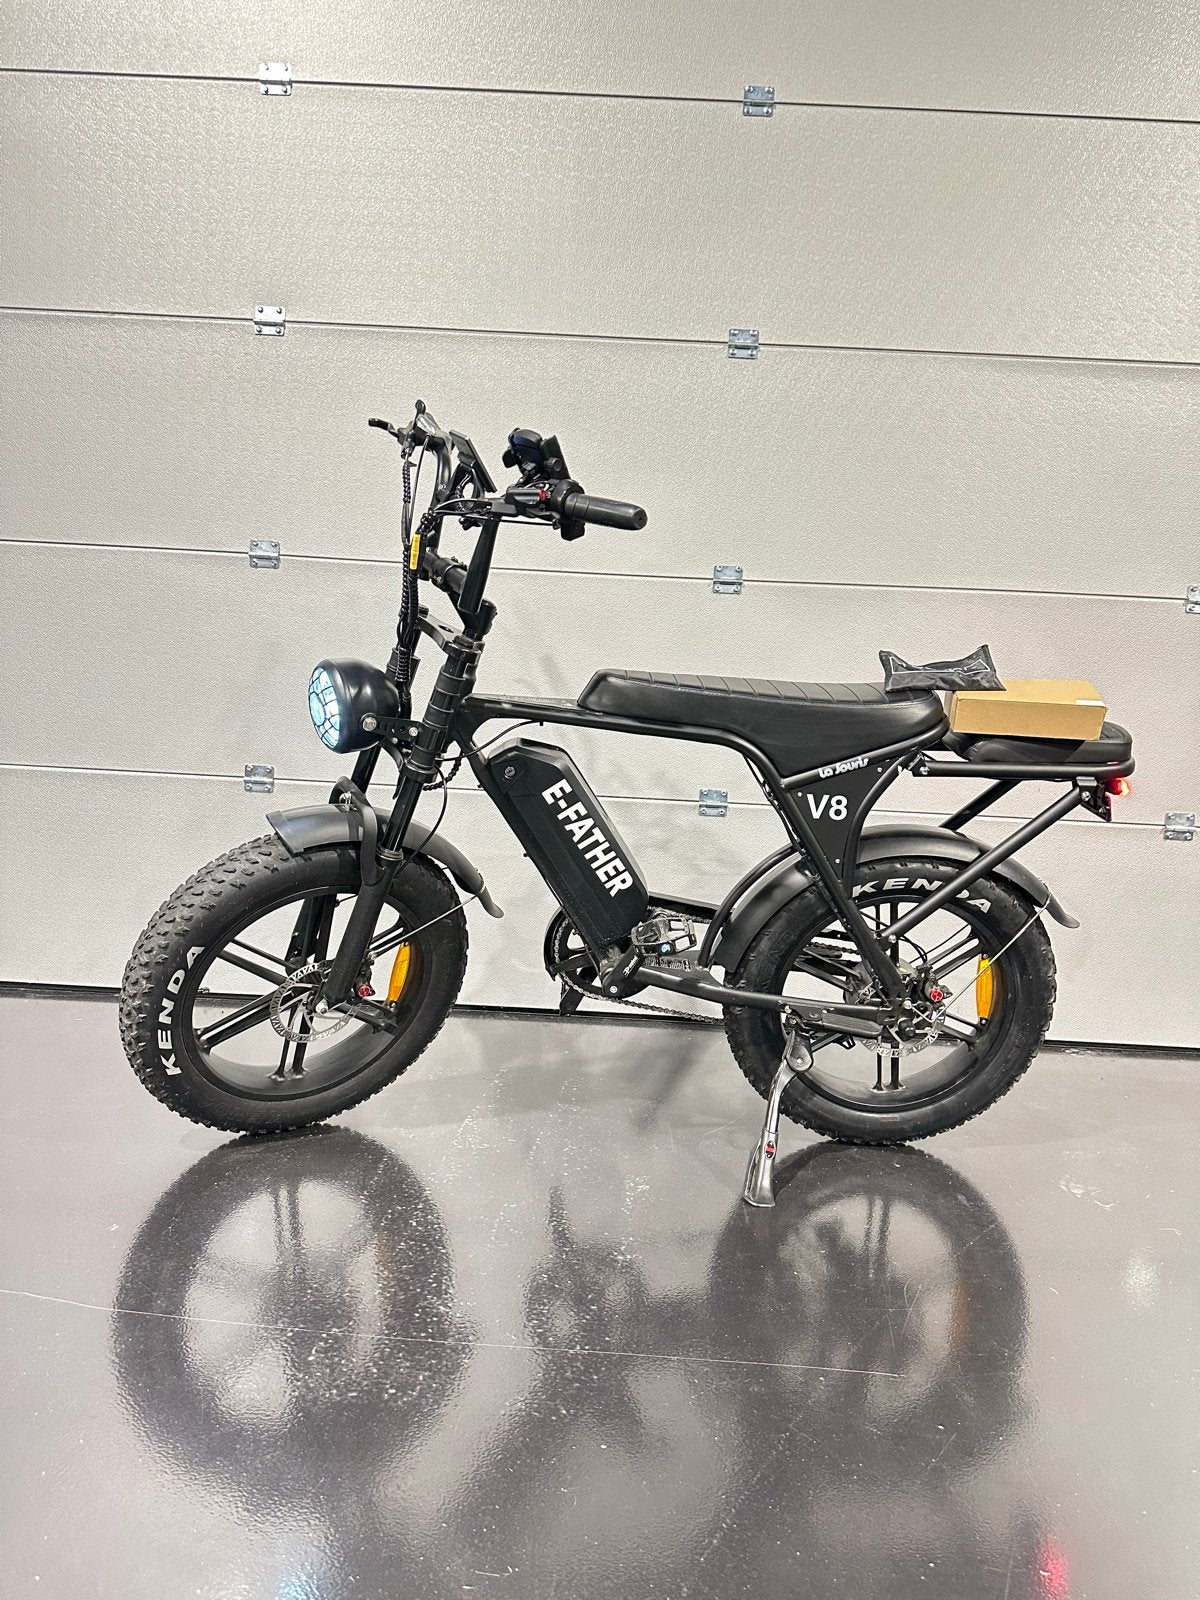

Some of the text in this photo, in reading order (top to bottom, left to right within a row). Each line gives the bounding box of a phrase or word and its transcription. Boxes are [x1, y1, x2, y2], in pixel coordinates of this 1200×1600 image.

[541, 778, 634, 898] E-FATHER
[806, 793, 848, 821] V8
[157, 945, 206, 1077] KENDA
